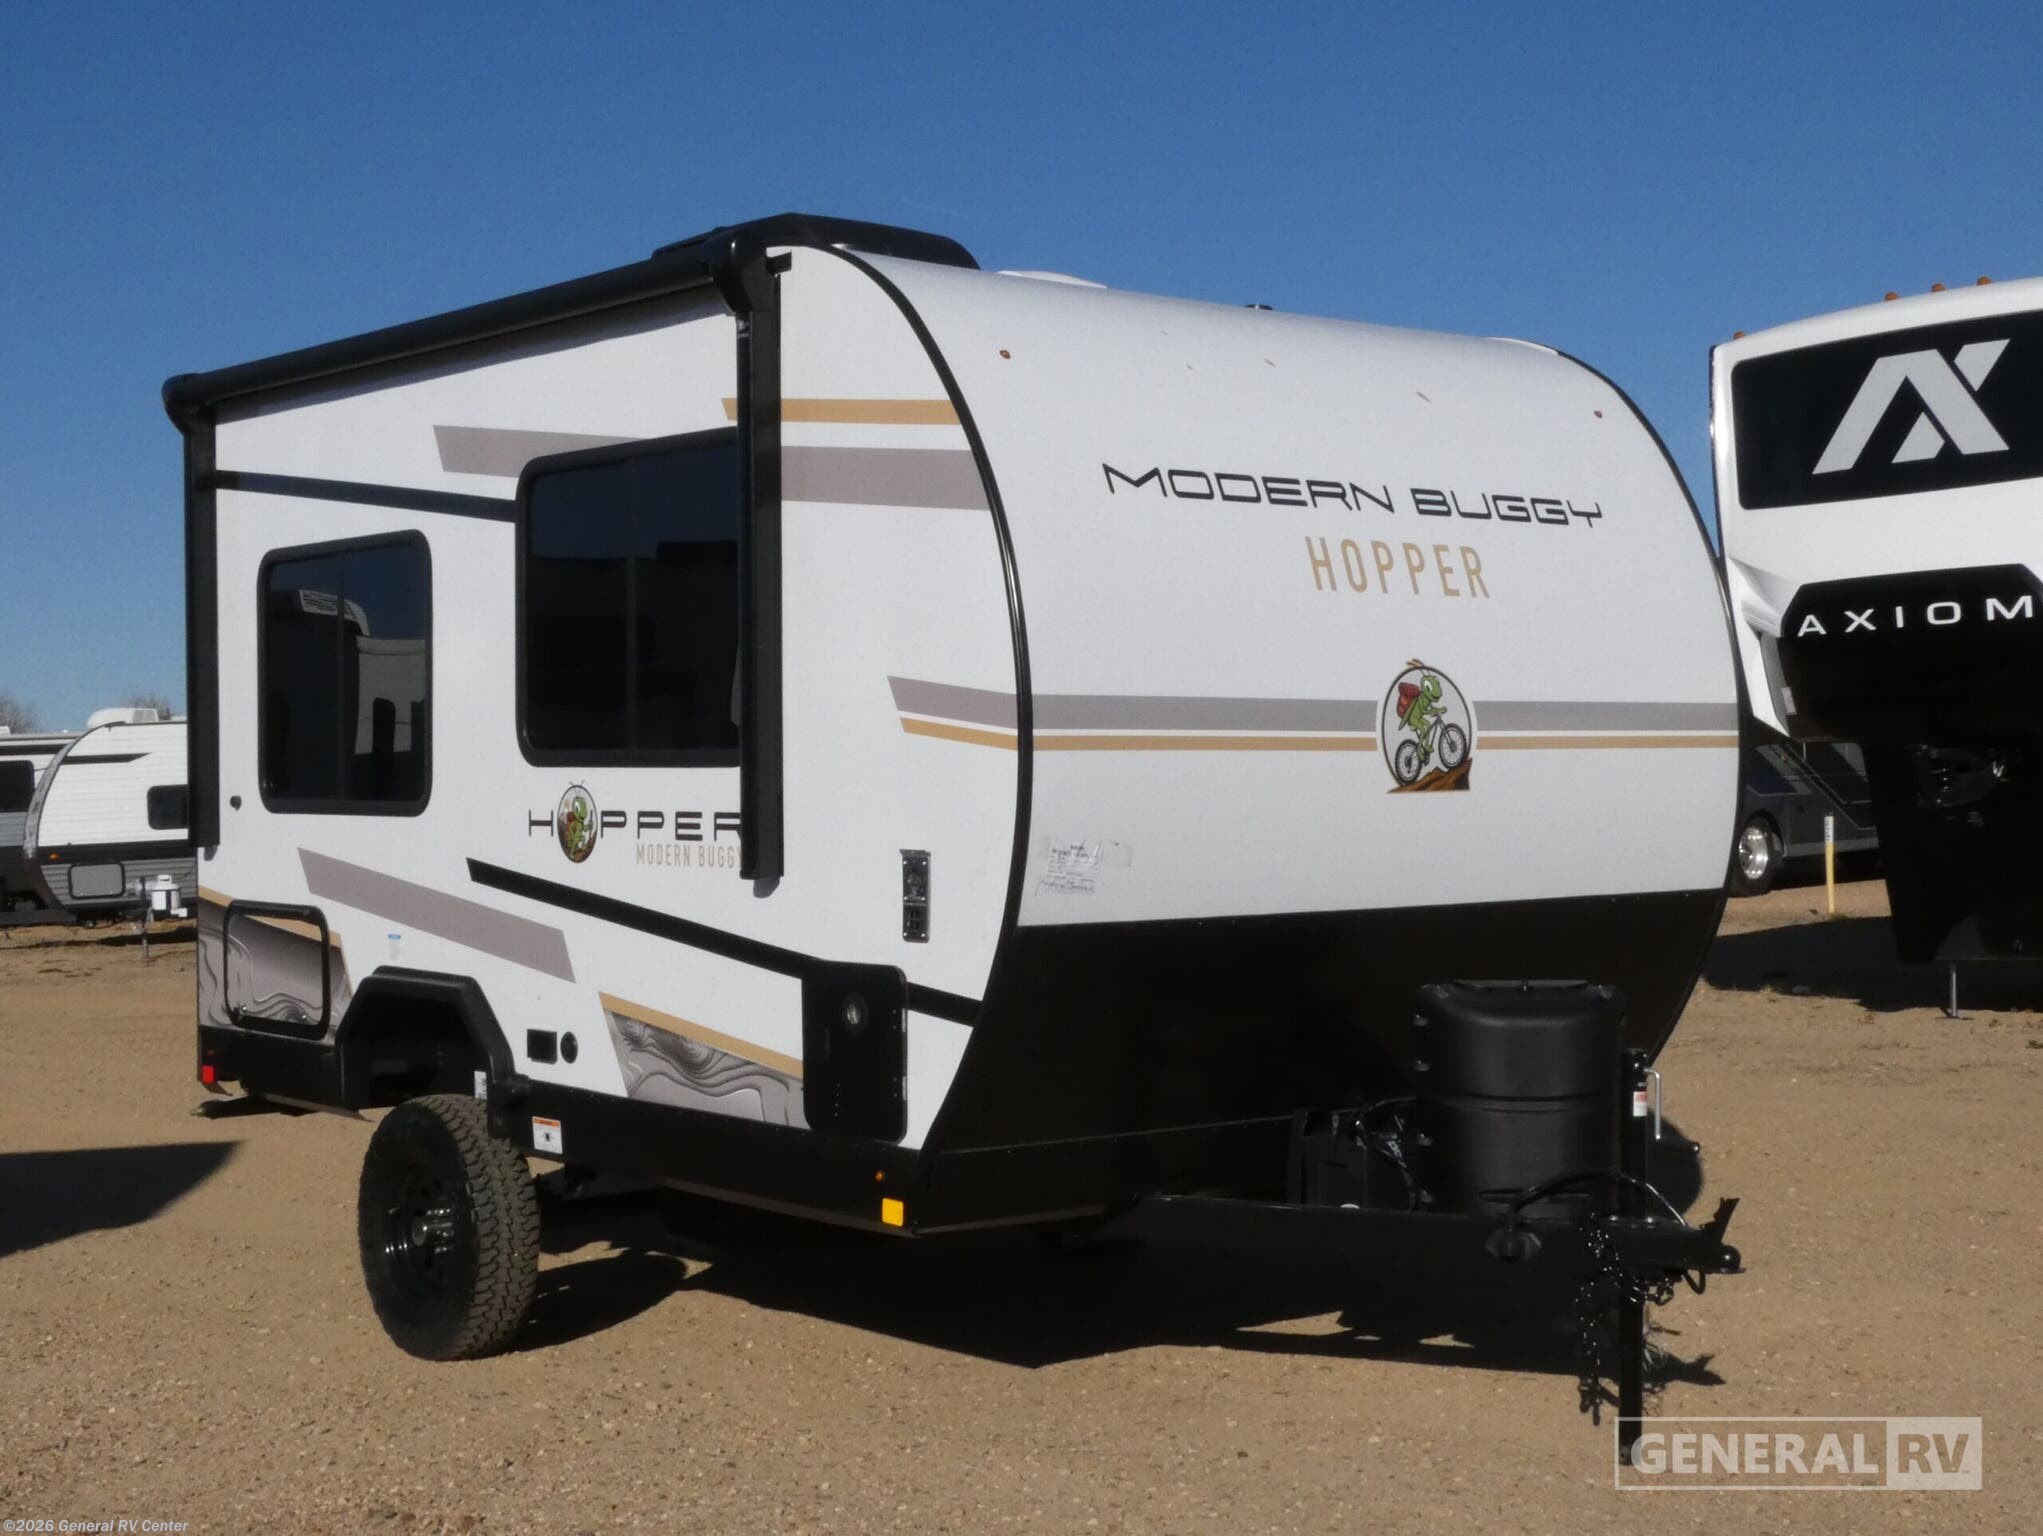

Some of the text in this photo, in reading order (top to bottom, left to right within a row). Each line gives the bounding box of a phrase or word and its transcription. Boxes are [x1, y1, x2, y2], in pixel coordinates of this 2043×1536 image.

[1102, 463, 1603, 528] MODERN BUGGY
[1305, 536, 1490, 599] HOPPER
[1798, 595, 2033, 637] AXIOM
[636, 843, 690, 867] MODERN
